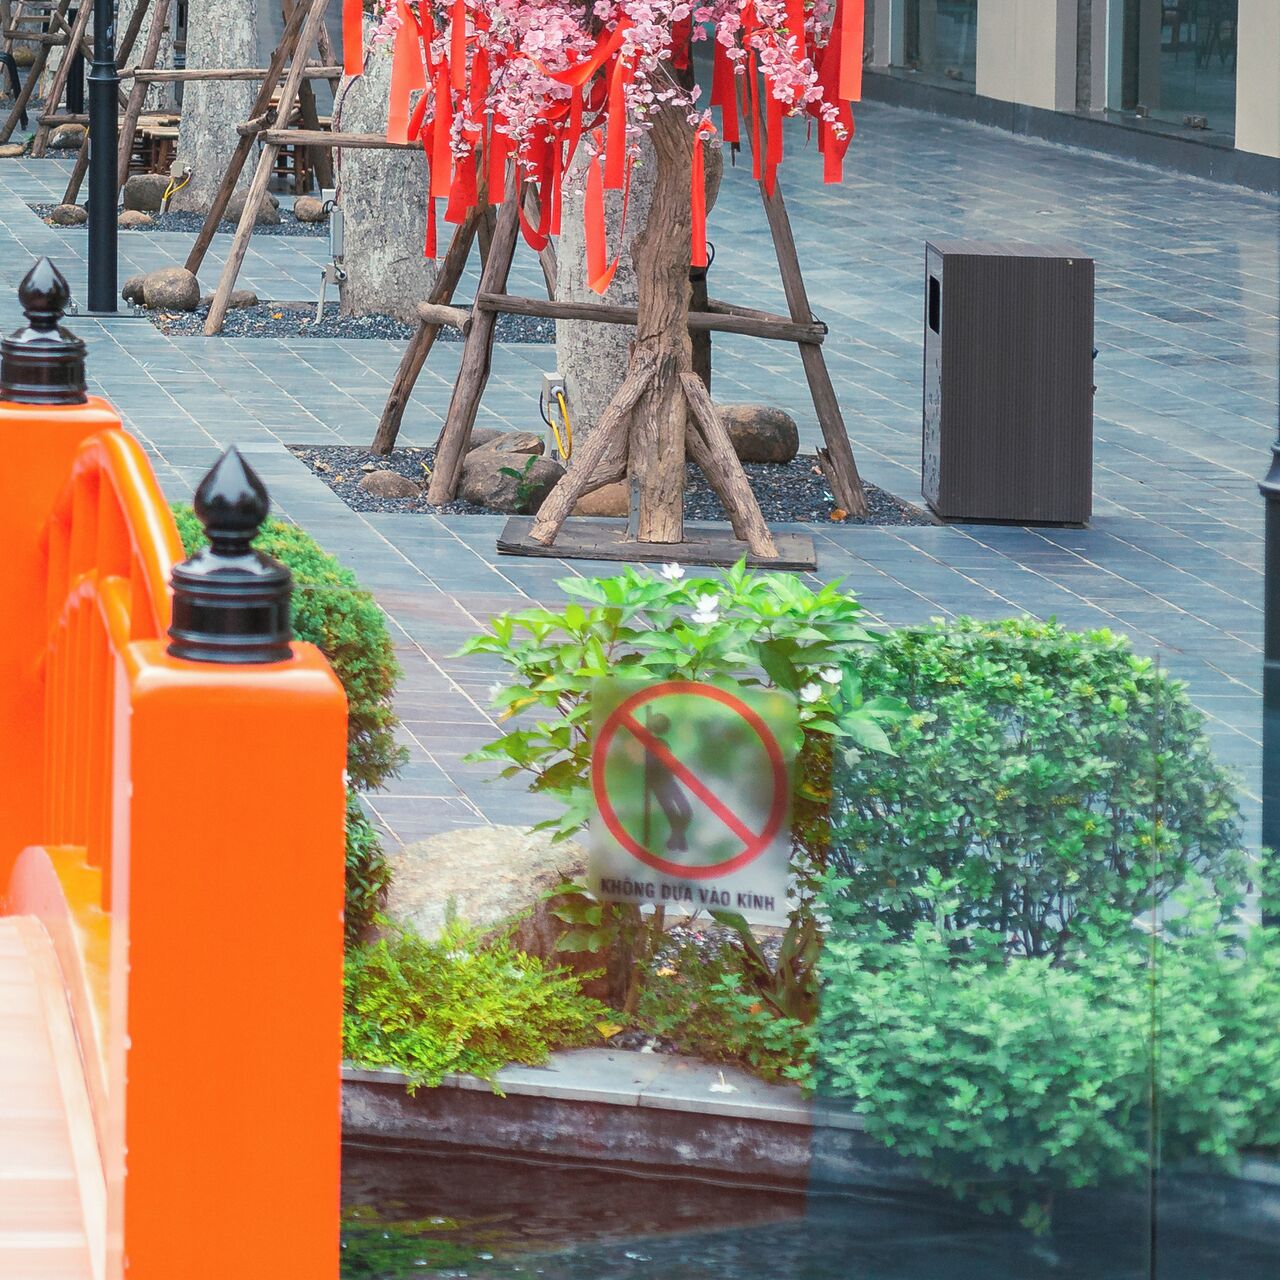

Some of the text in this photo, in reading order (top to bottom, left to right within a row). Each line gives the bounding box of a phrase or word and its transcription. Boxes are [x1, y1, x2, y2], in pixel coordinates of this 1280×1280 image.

[600, 877, 655, 899] KHÔNG
[698, 886, 730, 906] VÀO
[737, 891, 775, 911] KÍNH
